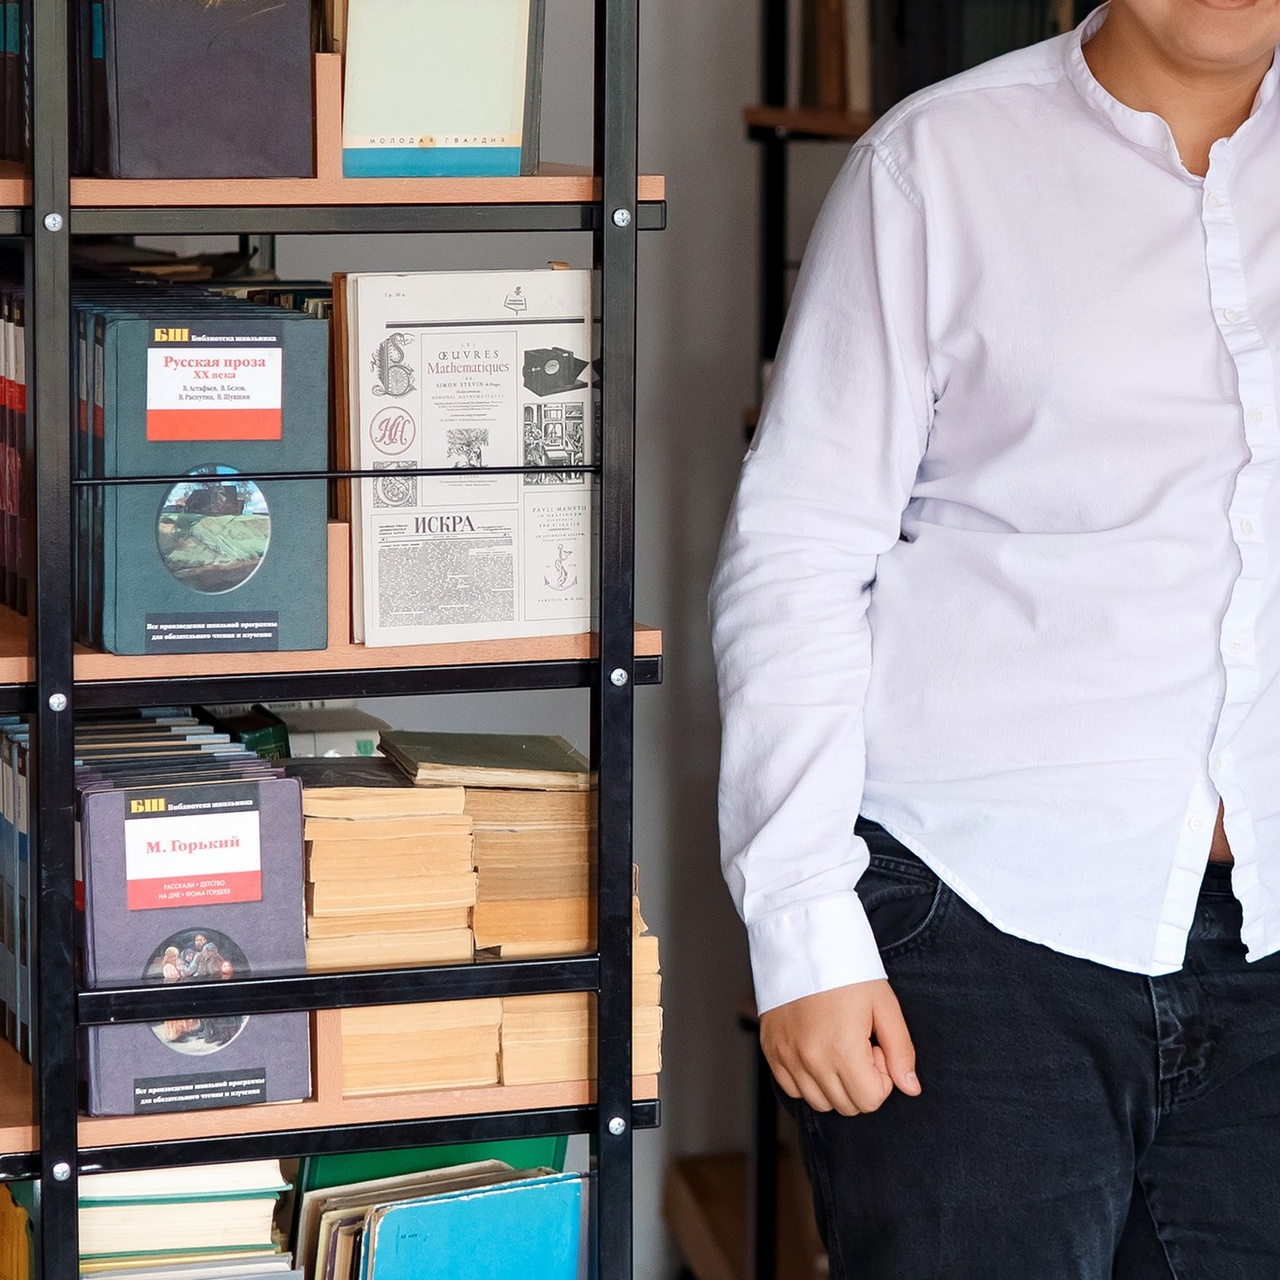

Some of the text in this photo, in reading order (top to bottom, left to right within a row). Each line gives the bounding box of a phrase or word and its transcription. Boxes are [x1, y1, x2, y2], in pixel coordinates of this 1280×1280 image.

[369, 136, 506, 145] МОЛОДАЯ ГВАРДИЯ
[154, 327, 190, 342] БШ
[191, 334, 235, 342] Библиотека
[163, 355, 266, 371] Русская проза
[427, 361, 510, 376] Mathematiques
[414, 515, 476, 534] ИСКРА
[130, 797, 254, 813] БШ Библиотека школьника
[146, 835, 241, 854] М. Горький
[163, 879, 226, 890] РАССКАЗЫ ДЕТСТВО
[185, 890, 206, 898] ФОМА
[206, 888, 231, 896] ГОРДЕЕВ
